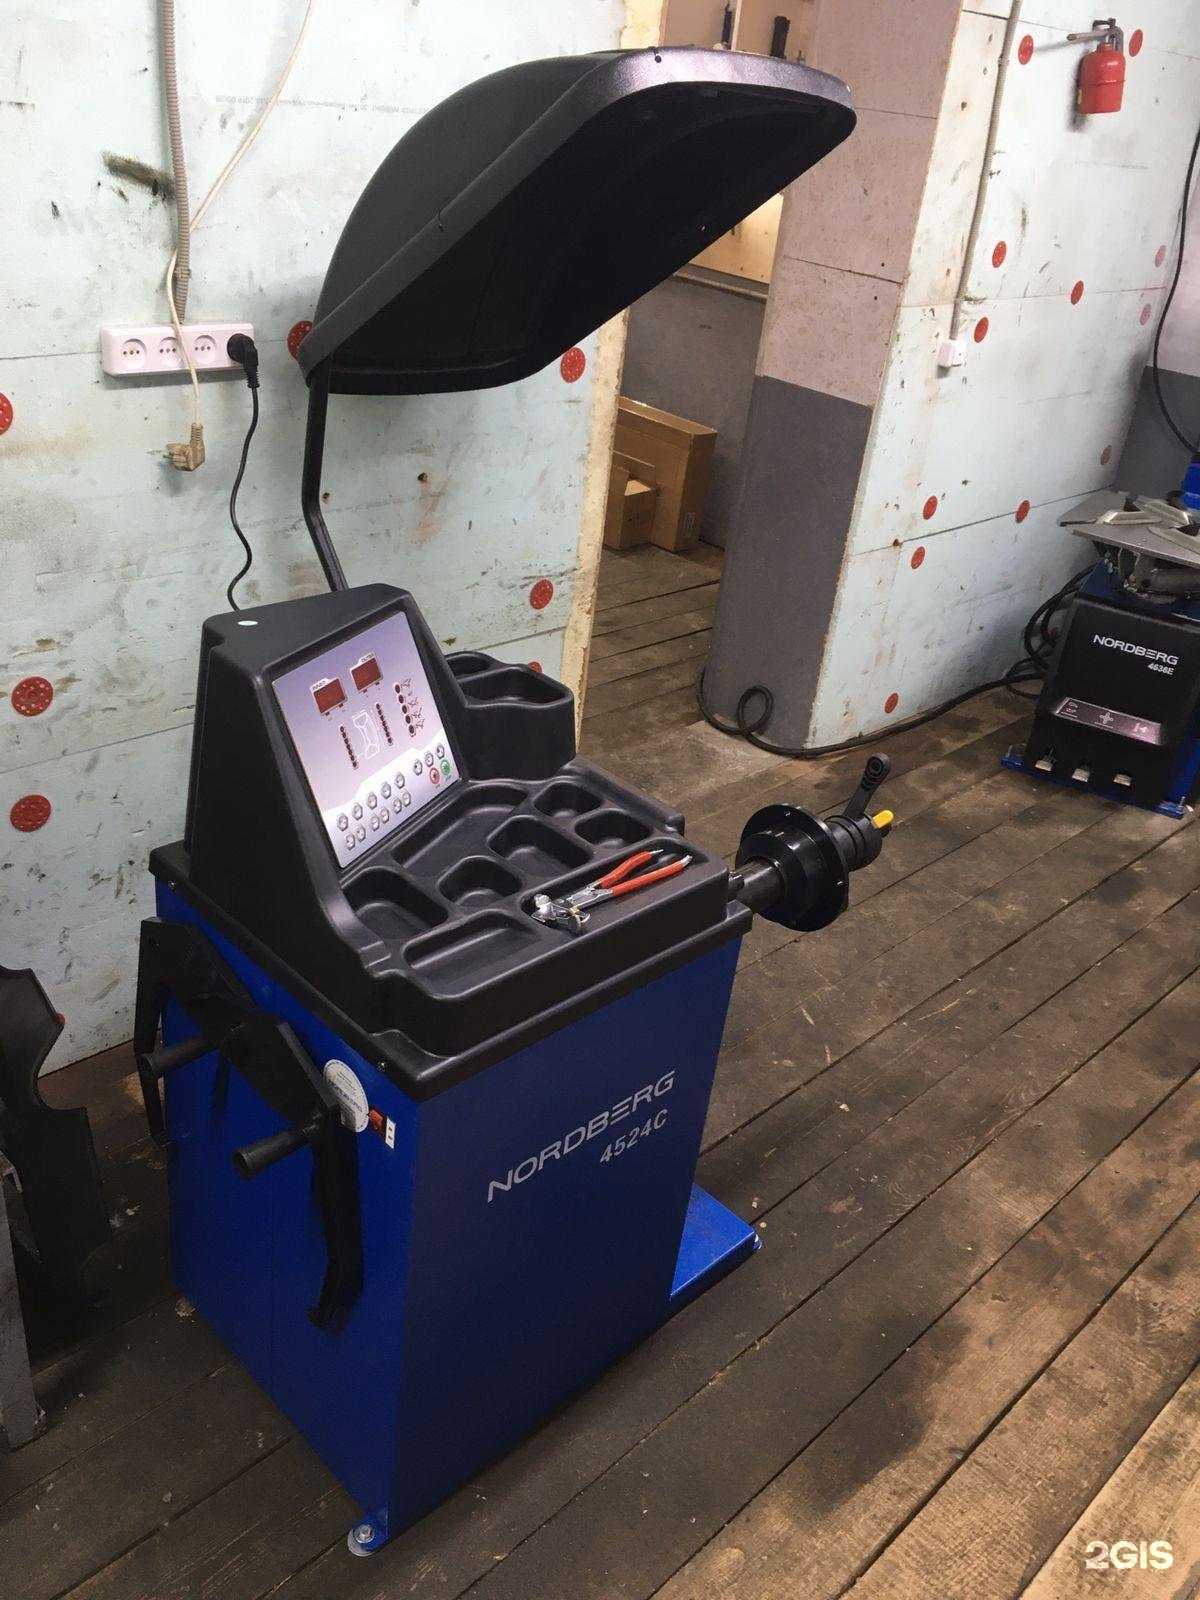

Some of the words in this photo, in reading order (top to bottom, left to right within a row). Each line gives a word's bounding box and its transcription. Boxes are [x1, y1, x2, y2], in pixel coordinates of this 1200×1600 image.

[1093, 634, 1179, 666] NORDBERG
[486, 1070, 676, 1203] NORDBERG
[599, 1108, 669, 1164] 4524C
